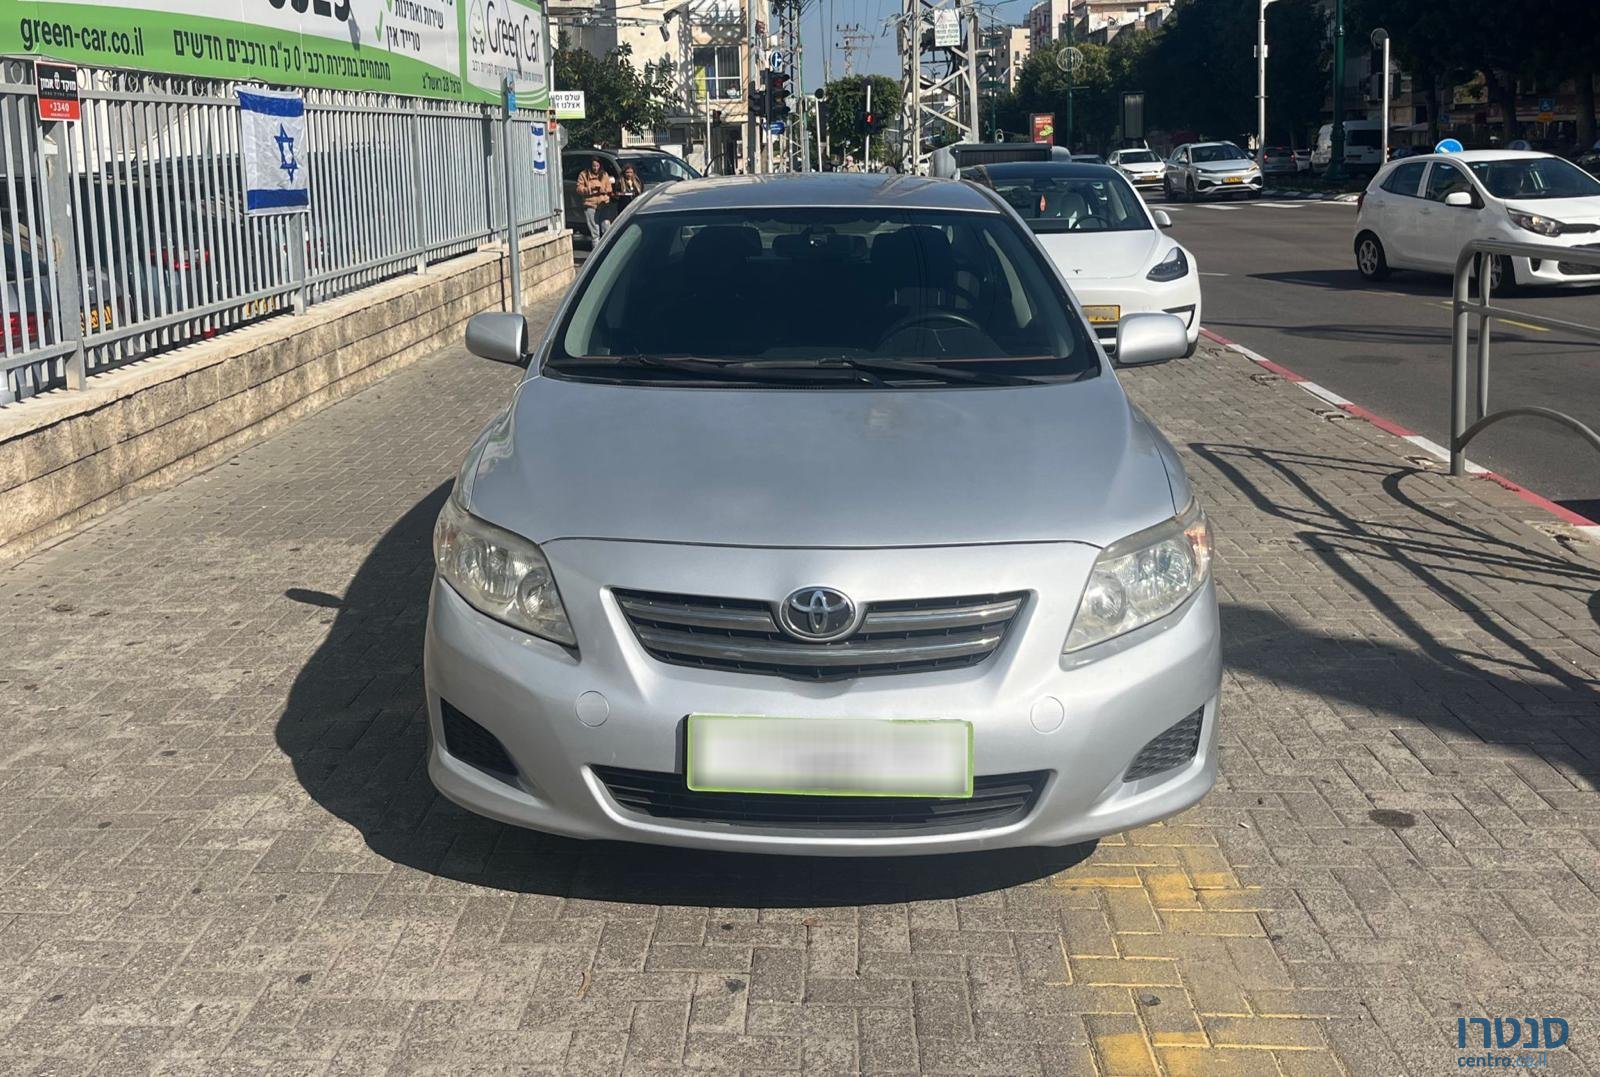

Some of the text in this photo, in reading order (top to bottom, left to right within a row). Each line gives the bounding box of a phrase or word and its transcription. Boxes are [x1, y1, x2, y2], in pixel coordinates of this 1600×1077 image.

[395, 0, 444, 30] שירות ואמינות
[20, 17, 144, 56] green-car.co.il
[173, 29, 223, 61] חדשים
[386, 25, 421, 52] טרייד אין
[486, 1, 540, 63] Green Car
[226, 38, 267, 67] ורכבים
[303, 51, 326, 73] רכבי
[326, 54, 359, 78] במכירת
[360, 59, 391, 81] מתמחים
[40, 78, 76, 92] מוקד אמון
[564, 93, 580, 101] שלם
